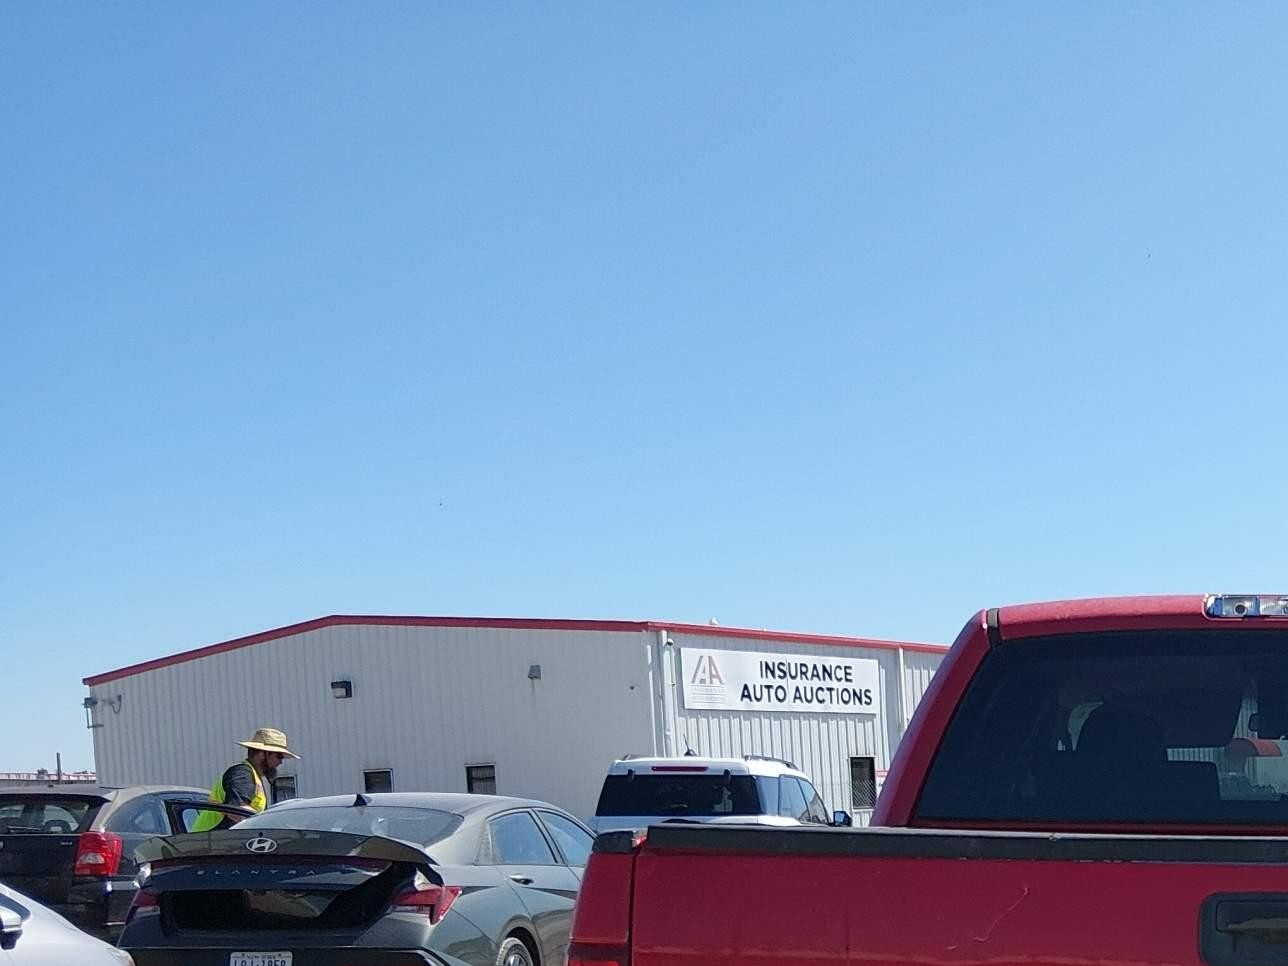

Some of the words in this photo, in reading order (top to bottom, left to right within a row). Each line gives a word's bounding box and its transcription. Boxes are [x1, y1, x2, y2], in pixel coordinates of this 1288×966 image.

[759, 660, 854, 683] INSURANCE
[740, 683, 788, 703] AUTO
[792, 686, 873, 706] AUCTIONS
